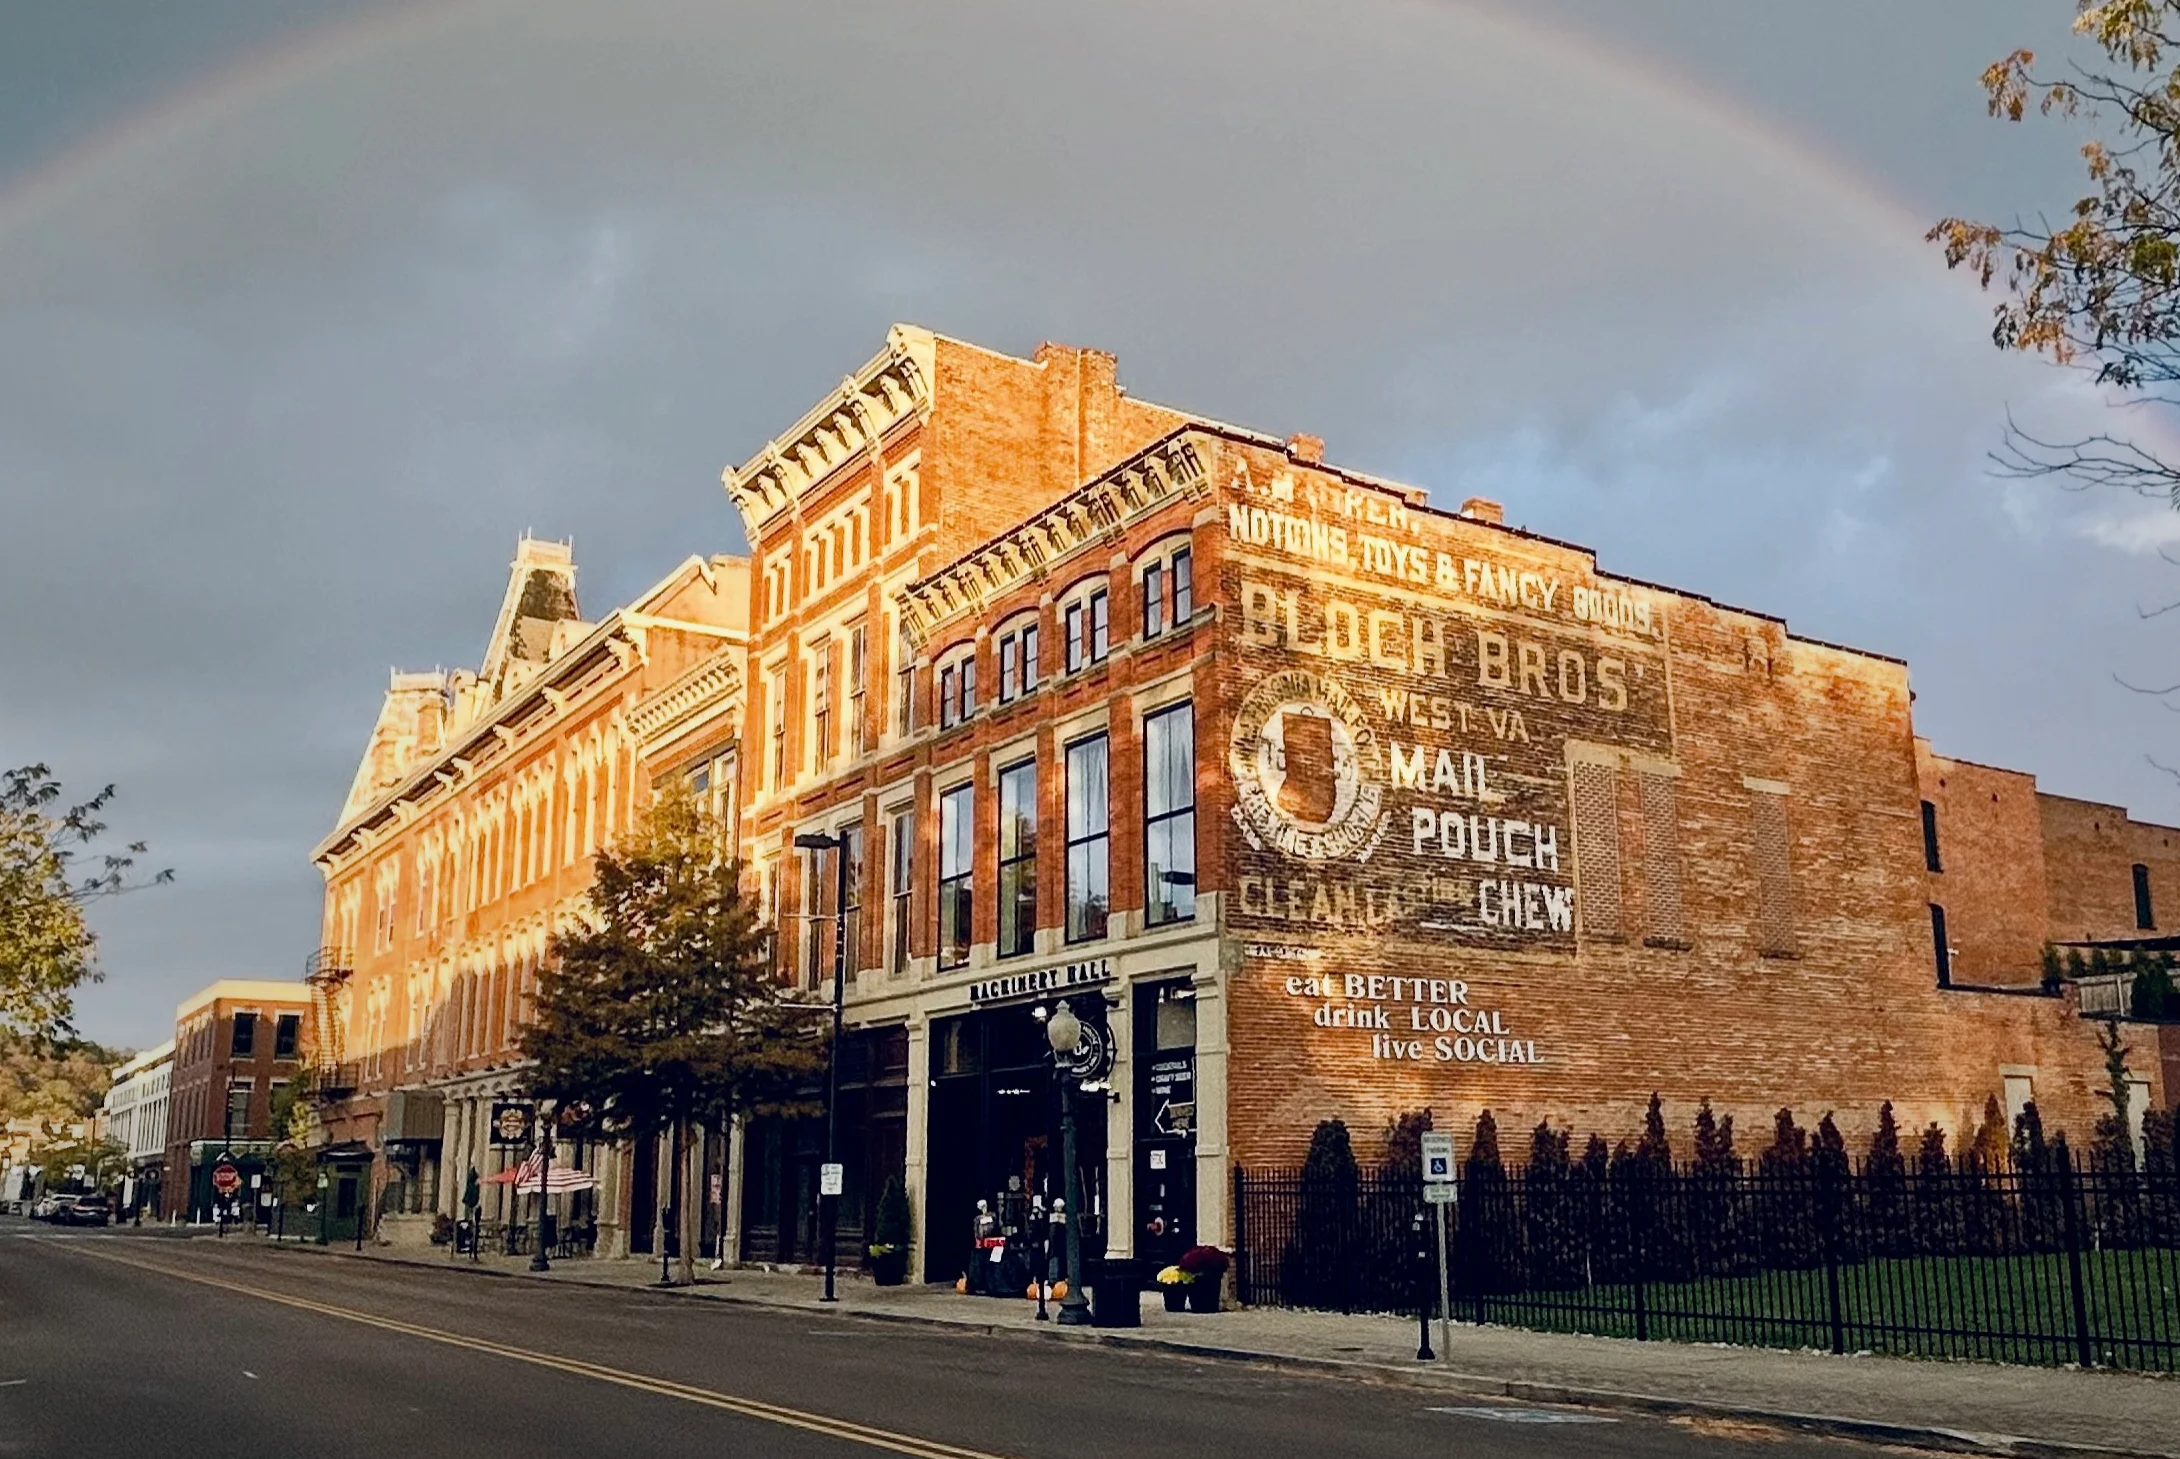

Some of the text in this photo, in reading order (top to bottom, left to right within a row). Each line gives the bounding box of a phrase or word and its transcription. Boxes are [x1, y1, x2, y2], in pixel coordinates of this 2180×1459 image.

[1357, 534, 1428, 587] TOYS
[1435, 552, 1461, 592] &
[1463, 558, 1559, 612] FANCY
[1240, 581, 1448, 678] BLOCH
[1390, 741, 1505, 803] MAIL
[1412, 807, 1559, 873] POUCH
[1480, 878, 1574, 932] CHEW
[970, 959, 1111, 1001] MACHINERY HALL
[1285, 973, 1469, 1005] eat BETTER
[1314, 1001, 1511, 1035] drink LOCAL
[1371, 1033, 1546, 1064] live SOCIAL
